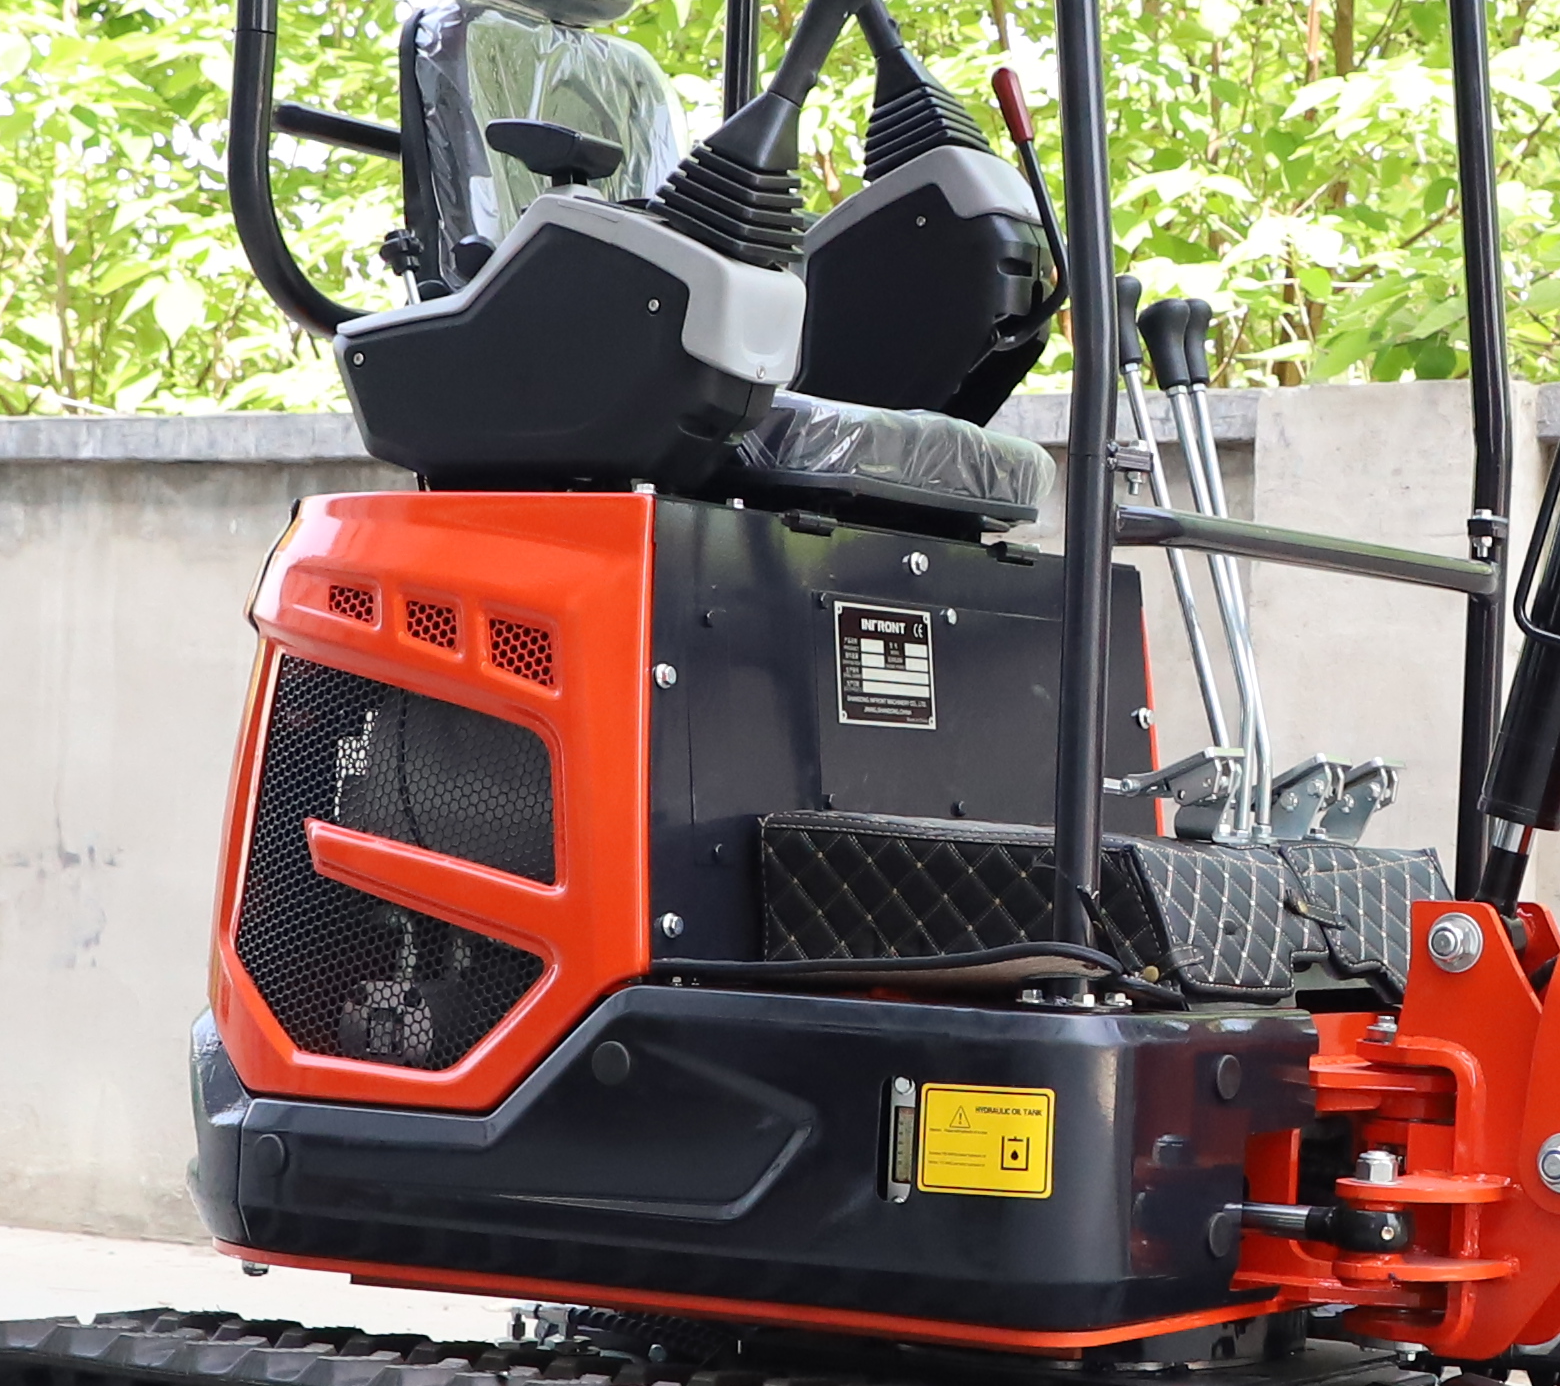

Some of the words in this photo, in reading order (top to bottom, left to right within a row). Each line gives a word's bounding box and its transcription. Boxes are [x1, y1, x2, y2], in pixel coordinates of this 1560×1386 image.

[861, 618, 906, 635] INFRONT
[913, 623, 924, 639] CE
[975, 1106, 1010, 1115] HYDRAULIC
[1023, 1108, 1043, 1116] TANK
